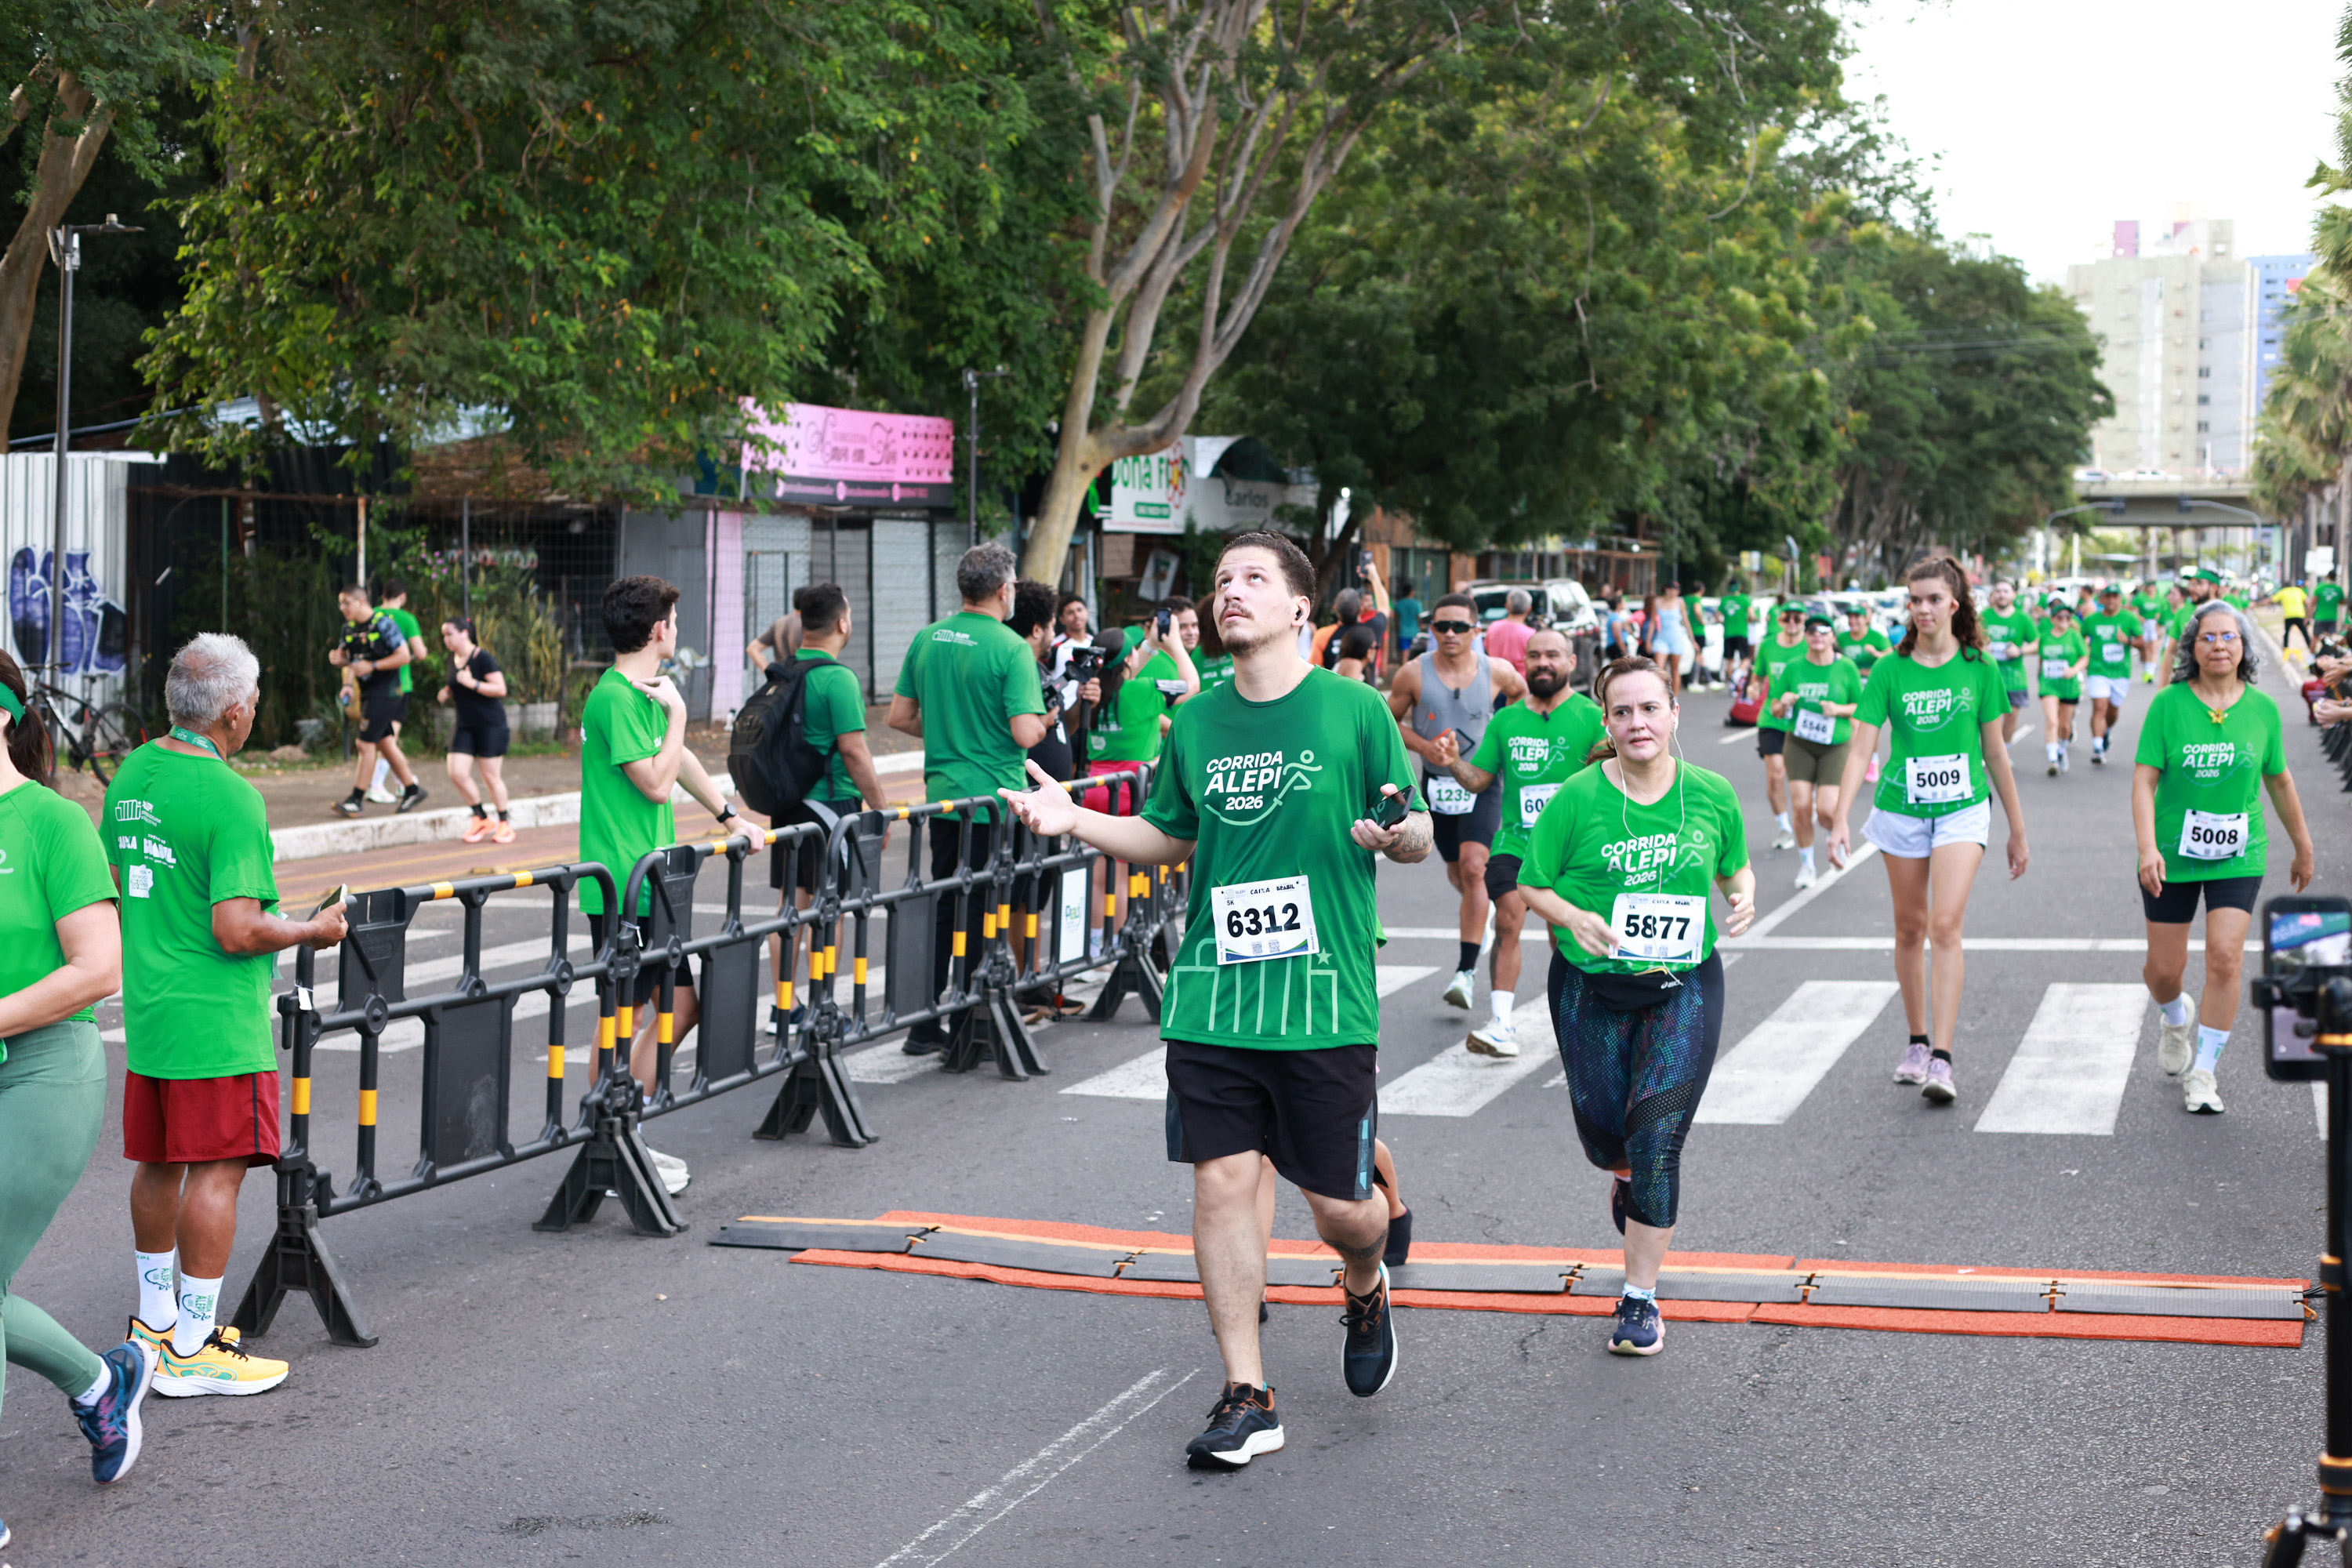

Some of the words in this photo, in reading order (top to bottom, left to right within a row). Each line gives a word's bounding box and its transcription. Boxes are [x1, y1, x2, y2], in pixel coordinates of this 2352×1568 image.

[1902, 688, 1952, 702] CORRIDA
[1904, 698, 1952, 716] ALEPI
[1916, 714, 1940, 725] 2026
[1508, 736, 1549, 747] CORRIDA
[2183, 742, 2234, 754] CORRIDA
[1511, 746, 1549, 761] ALEPI
[2182, 753, 2234, 768] ALEPI
[1206, 750, 1283, 773] CORRIDA
[1518, 762, 1539, 771] 2026
[1204, 766, 1283, 796] ALEPI
[1916, 770, 1960, 787] 5009
[2195, 769, 2220, 778] 2026
[1225, 795, 1263, 810] 2026
[1436, 789, 1471, 802] 1235
[2191, 826, 2238, 844] 5008
[1601, 833, 1677, 857] CORRIDA
[1607, 847, 1677, 873] ALEPI
[1624, 870, 1657, 886] 2026
[1227, 903, 1301, 938] 6312
[1624, 914, 1690, 940] 5877
